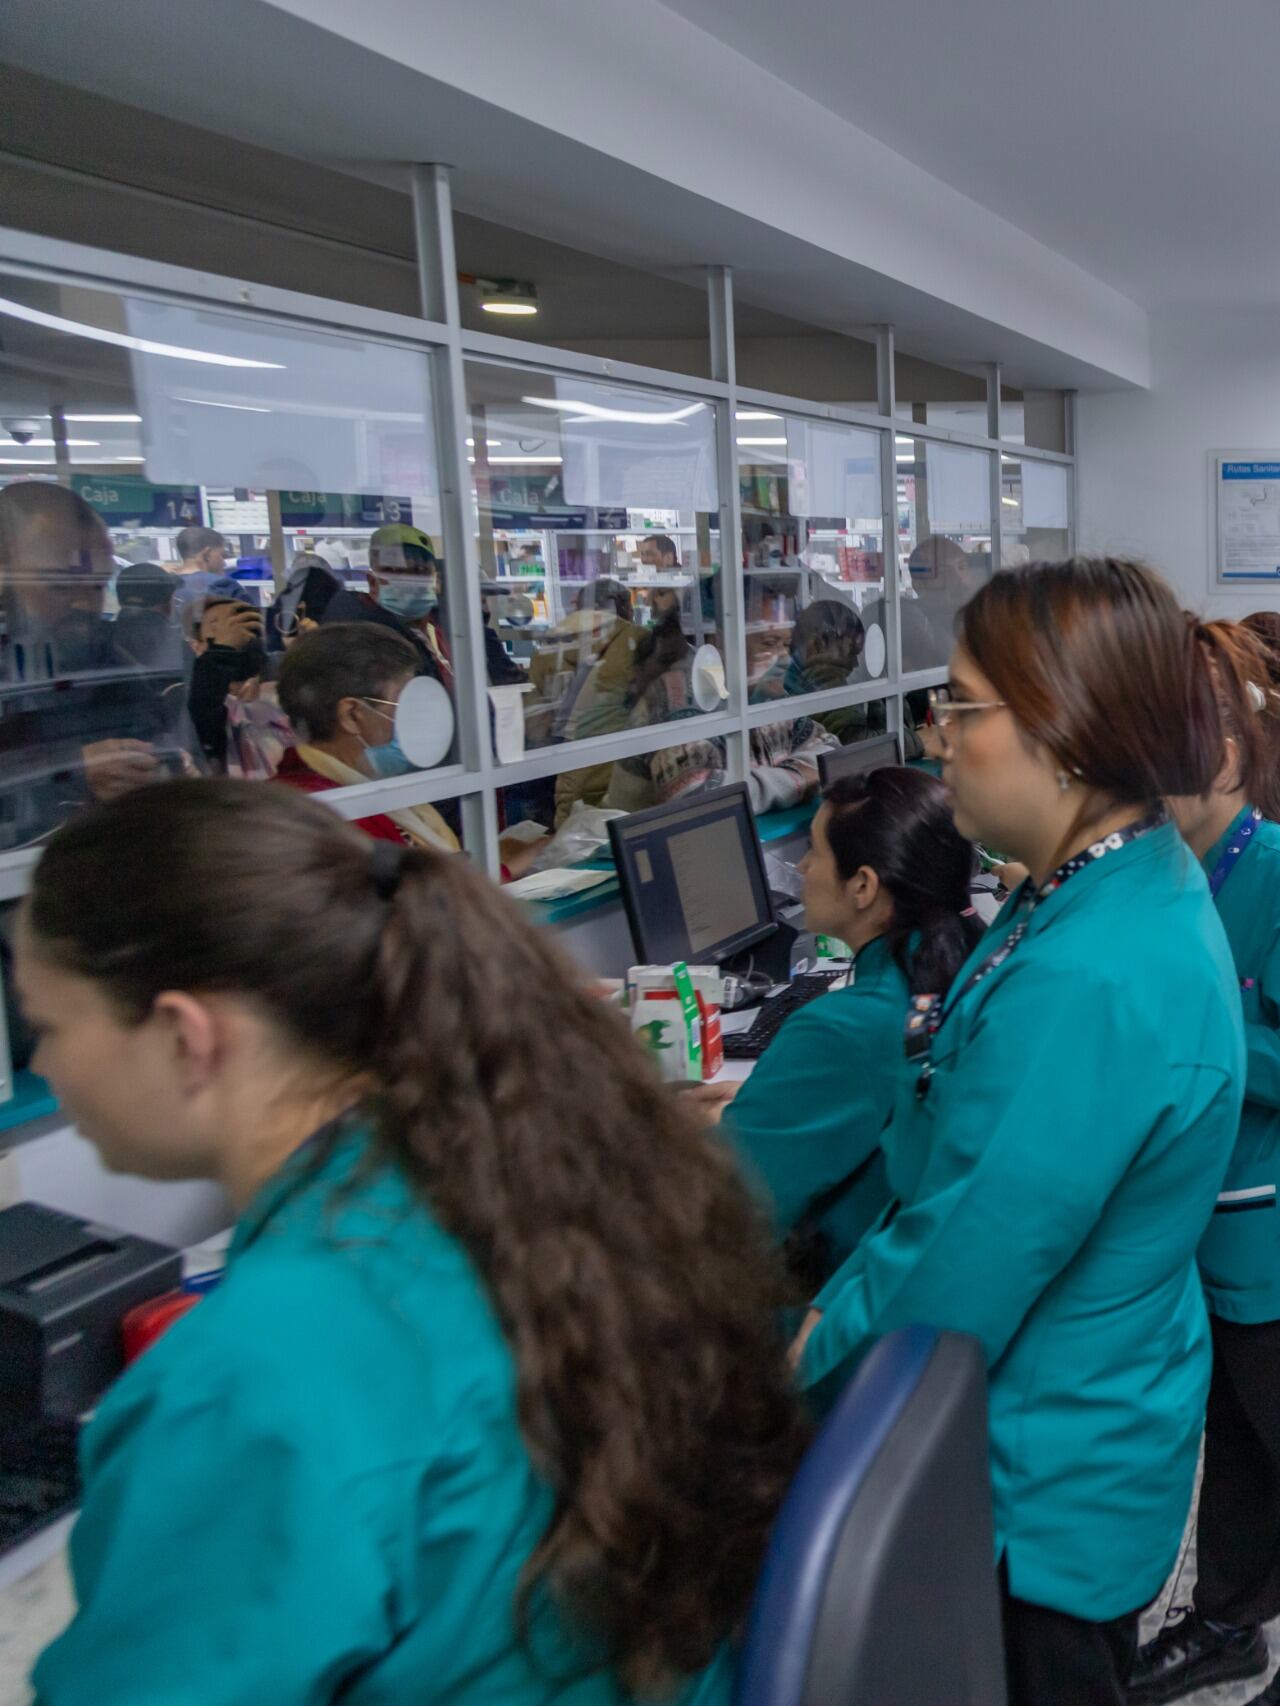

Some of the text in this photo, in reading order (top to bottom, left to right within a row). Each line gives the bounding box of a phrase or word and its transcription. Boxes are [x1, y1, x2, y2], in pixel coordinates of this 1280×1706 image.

[1227, 465, 1251, 473] Rutas
[81, 486, 119, 505] Caja
[288, 490, 327, 506] Caja
[500, 487, 540, 507] Caja
